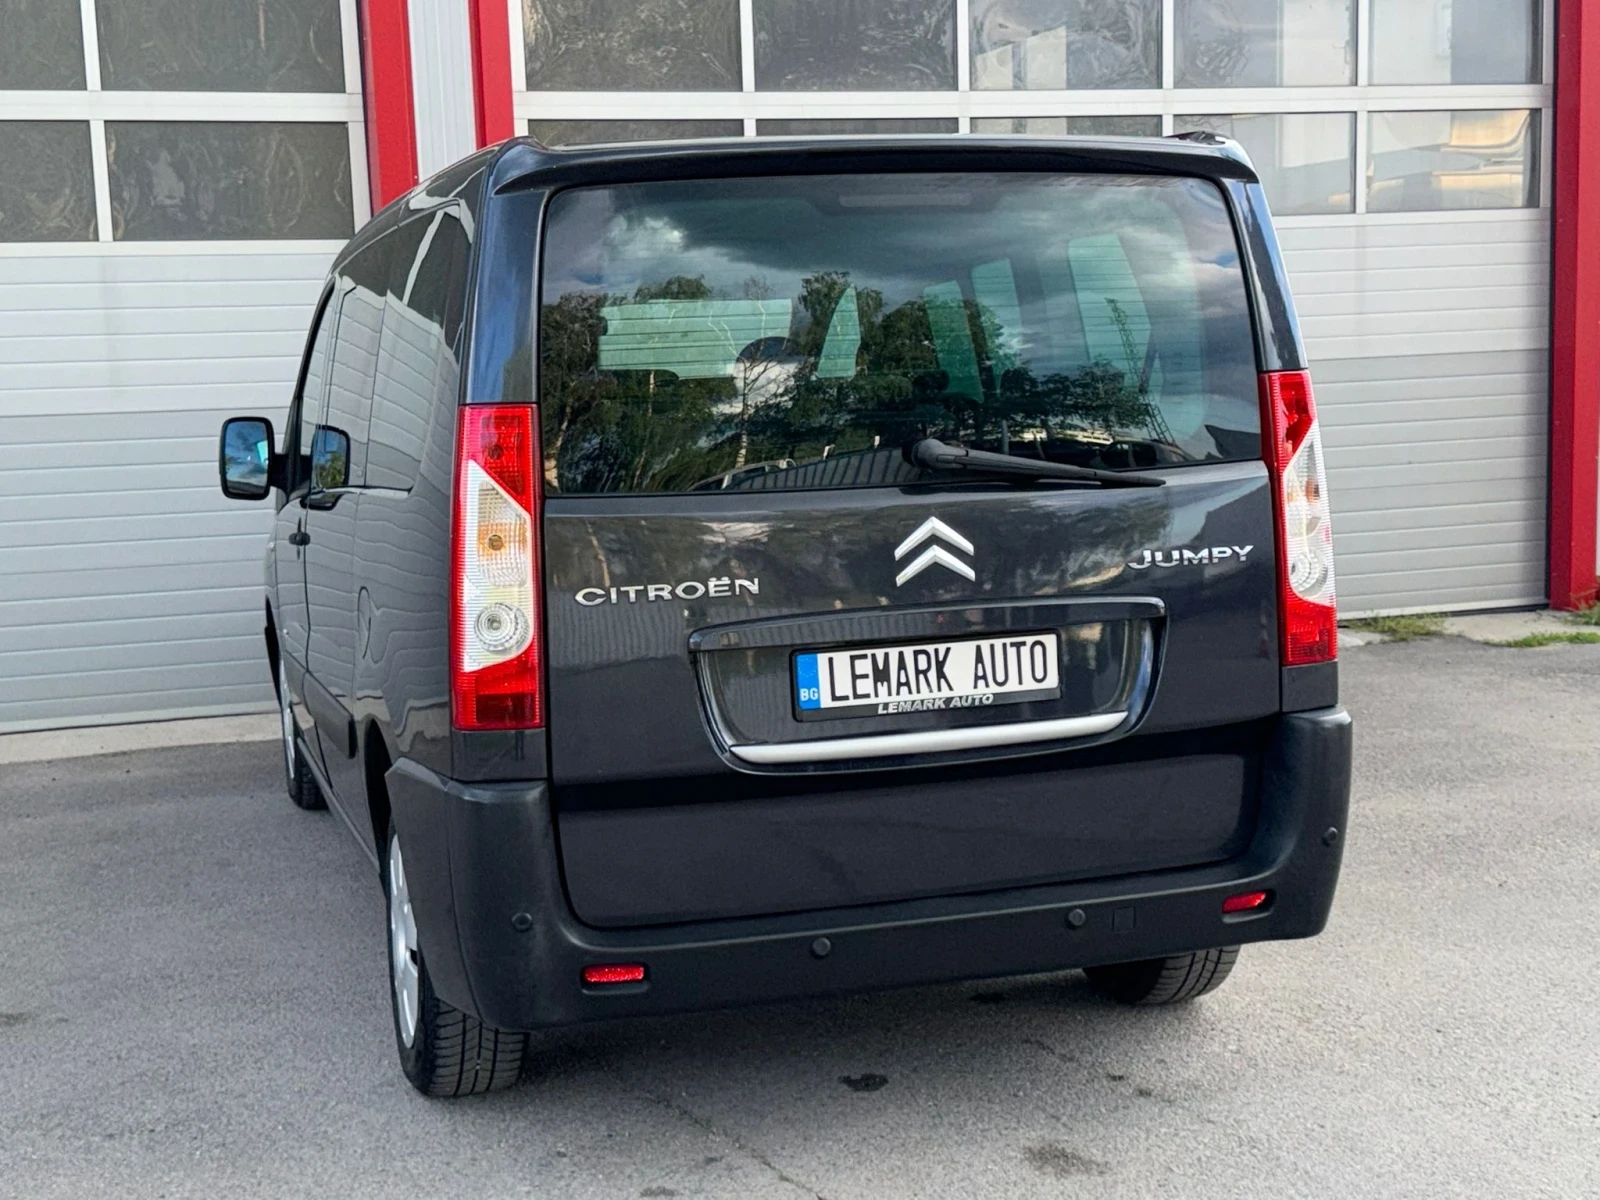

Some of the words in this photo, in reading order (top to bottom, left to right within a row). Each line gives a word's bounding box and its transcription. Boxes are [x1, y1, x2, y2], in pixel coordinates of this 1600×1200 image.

[1127, 545, 1254, 569] JUMPY
[575, 576, 760, 606] CITROËN
[828, 646, 954, 702] LEMARK
[973, 640, 1048, 690] AUTO
[800, 687, 819, 701] BG
[877, 697, 946, 715] LEMARK
[949, 693, 994, 708] AUTO
